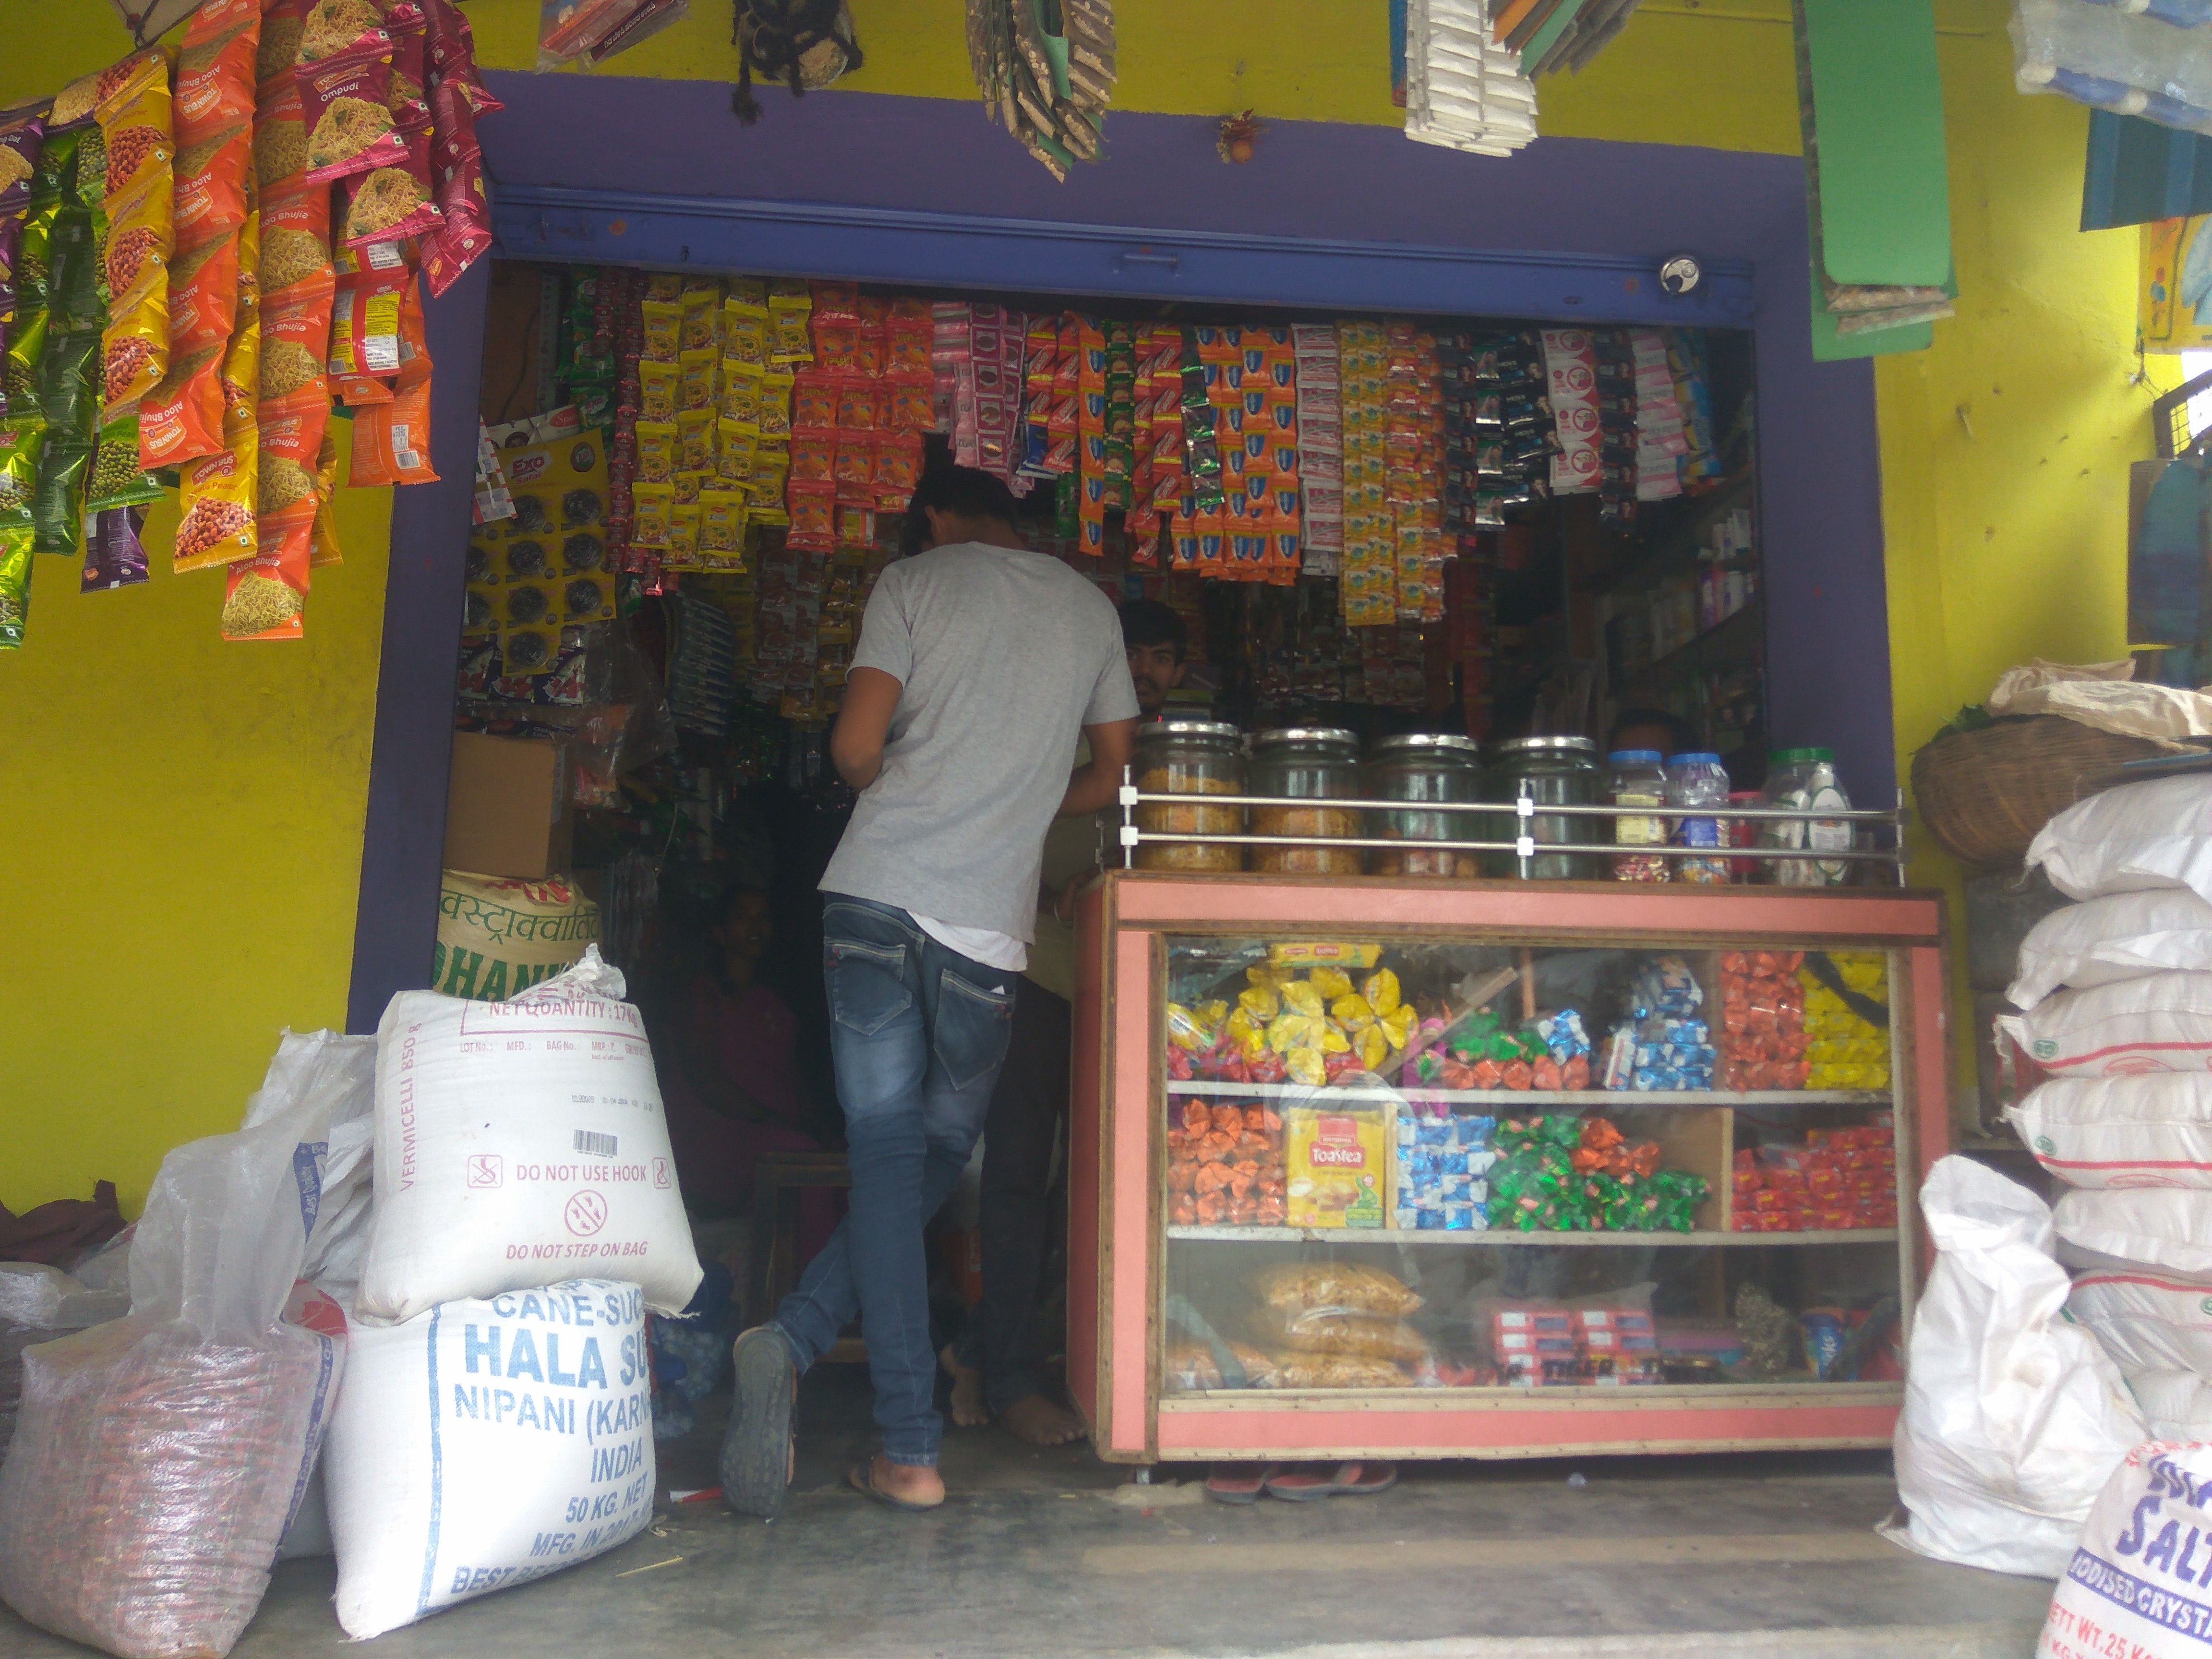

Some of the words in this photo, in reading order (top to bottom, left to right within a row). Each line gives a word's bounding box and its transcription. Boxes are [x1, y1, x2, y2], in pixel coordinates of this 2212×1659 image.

[321, 82, 359, 102] Ompudi
[278, 210, 308, 221] Bhujia
[276, 322, 306, 332] Bhujia
[164, 401, 183, 417] Aloo
[149, 438, 163, 449] BUS
[162, 426, 182, 445] TOWN
[269, 438, 300, 448] Bhujia
[194, 461, 217, 480] TOWN
[218, 456, 234, 467] BUS
[236, 561, 254, 576] Aloo
[255, 557, 281, 567] Bhujia
[524, 998, 605, 1018] QUANTITY
[399, 1077, 416, 1191] VERMICELLI
[517, 1164, 541, 1181] DO
[546, 1165, 579, 1181] NOT
[582, 1165, 609, 1182] USE
[612, 1165, 647, 1182] HOOK
[505, 1244, 529, 1260] DO
[531, 1244, 564, 1260] NOT
[565, 1243, 598, 1259] STEP
[600, 1242, 622, 1257] ON
[622, 1241, 649, 1256] BAG
[464, 1323, 608, 1390] HALA
[454, 1383, 575, 1435] NIPANI
[590, 1436, 643, 1483] INDIA
[565, 1495, 589, 1524] 50
[590, 1491, 618, 1522] KG.
[622, 1470, 649, 1510] NET
[529, 1531, 577, 1557] MFG.
[579, 1526, 604, 1551] IN
[450, 1565, 517, 1594] BEST
[2071, 1553, 2135, 1605] IODISED
